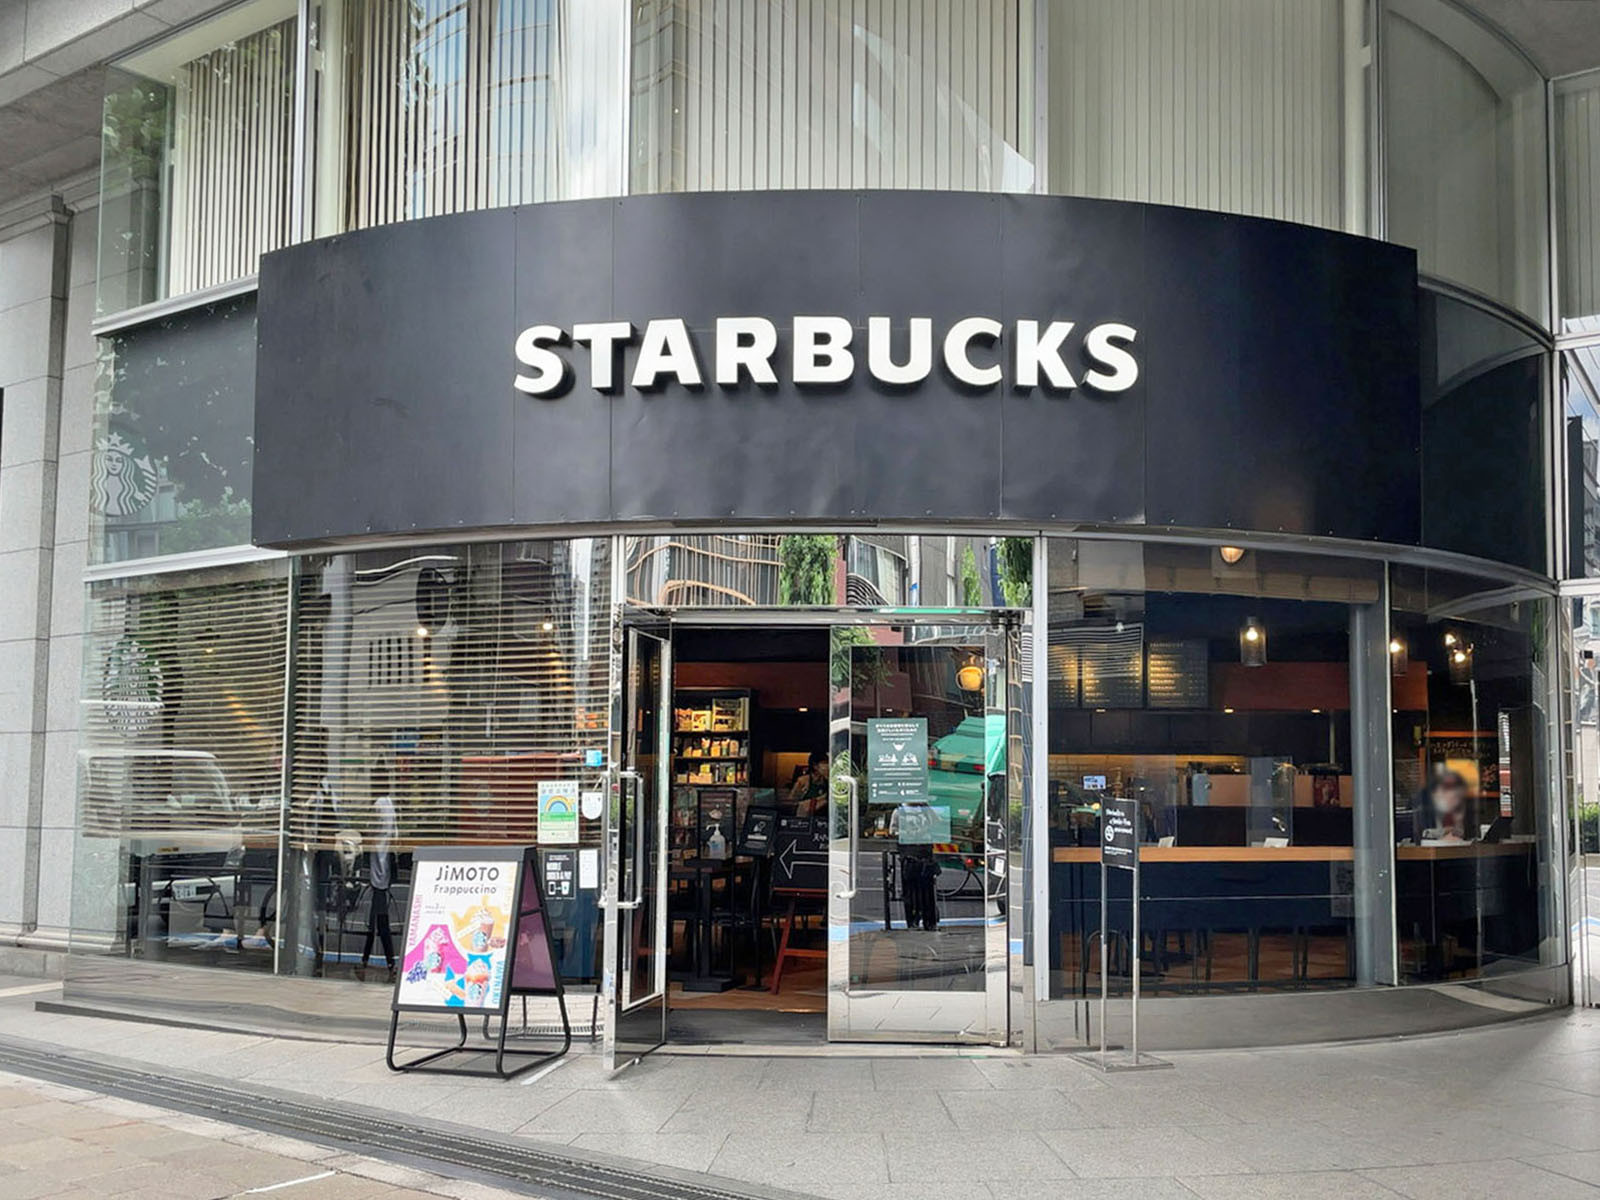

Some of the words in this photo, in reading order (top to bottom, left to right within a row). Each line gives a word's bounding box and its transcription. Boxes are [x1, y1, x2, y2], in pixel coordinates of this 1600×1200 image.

[514, 316, 1139, 393] STARBUCKS
[433, 884, 497, 895] Frappuccino
[436, 865, 500, 881] JiMOTO
[408, 894, 423, 947] YAMANASHI
[492, 961, 505, 1005] OKINAWA
